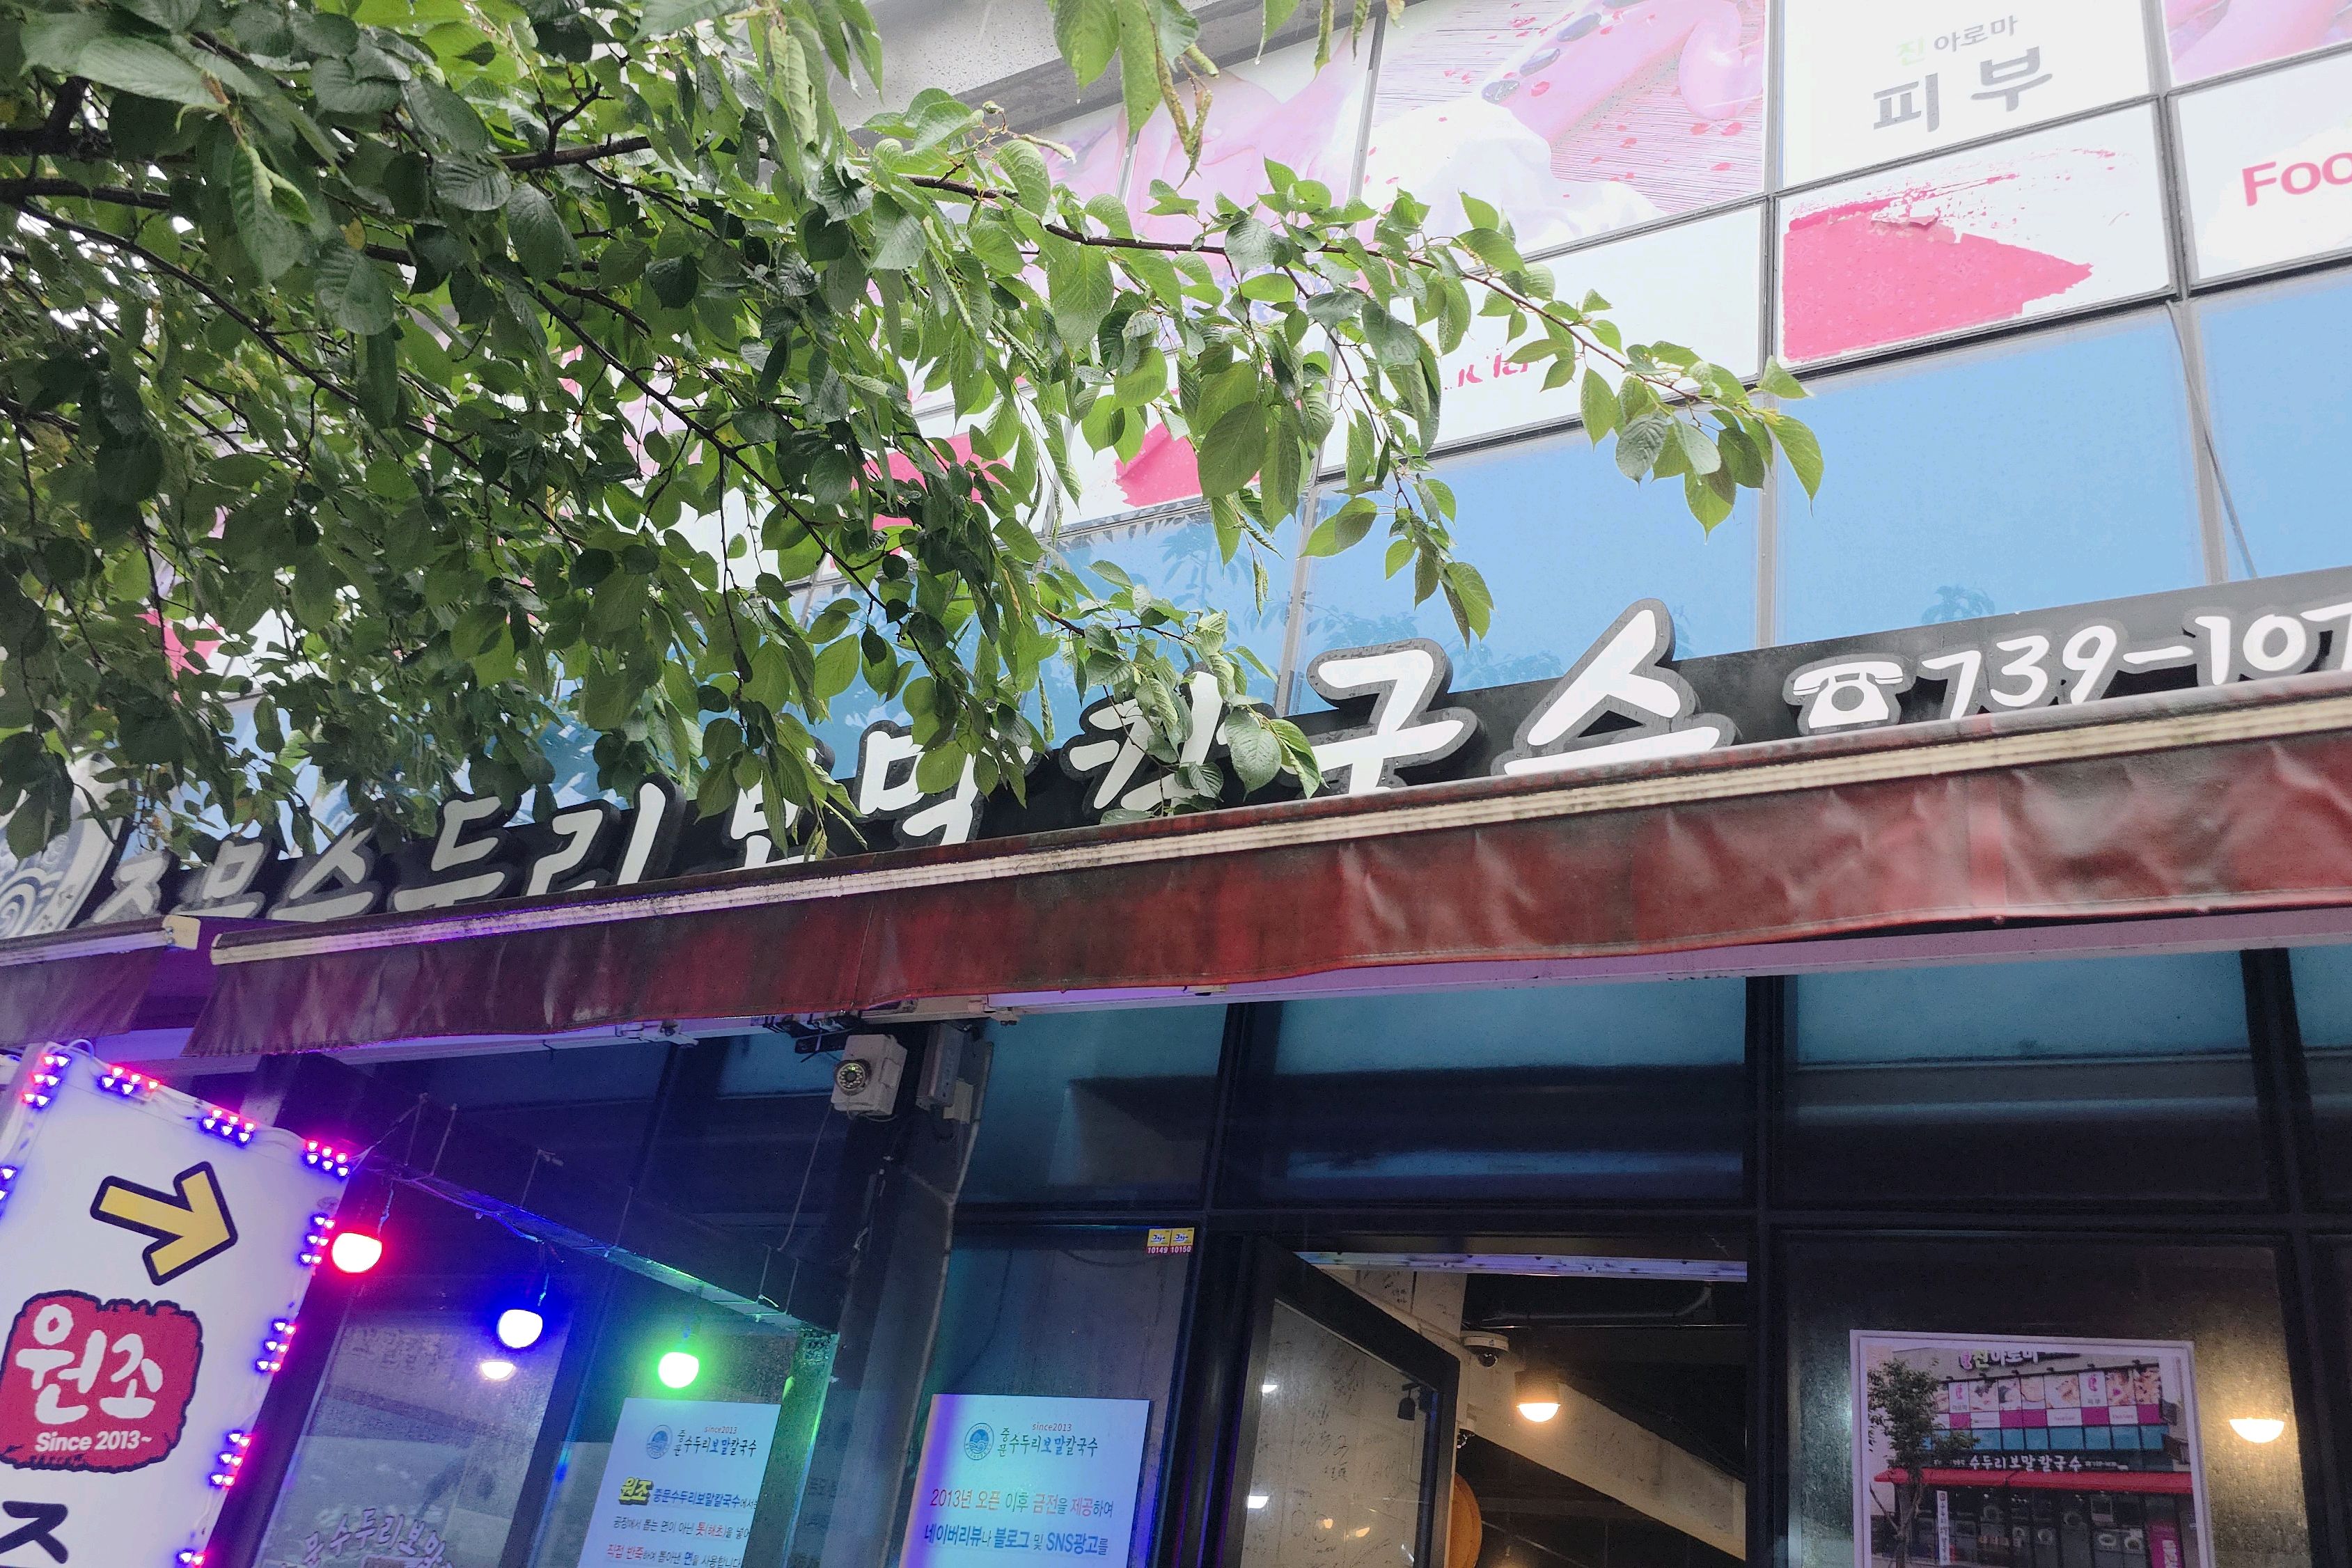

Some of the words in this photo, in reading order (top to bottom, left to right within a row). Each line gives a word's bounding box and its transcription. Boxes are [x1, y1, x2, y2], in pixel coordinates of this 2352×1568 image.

[1934, 15, 2018, 52] 아로마
[16, 1304, 164, 1425] 원조
[35, 1432, 92, 1452] Since
[705, 1426, 738, 1434] since2013
[1032, 1422, 1073, 1432] since2013
[930, 1488, 973, 1510] 2013년
[975, 1490, 1001, 1511] 오픈
[1005, 1491, 1029, 1513] 이후
[1033, 1493, 1068, 1514] 금전을
[1069, 1497, 1113, 1519] 제공하여
[924, 1522, 991, 1546] 네이버리뷰나
[994, 1527, 1030, 1549] 블로그
[1033, 1533, 1044, 1551] 및
[1046, 1530, 1108, 1555] SNS광고를
